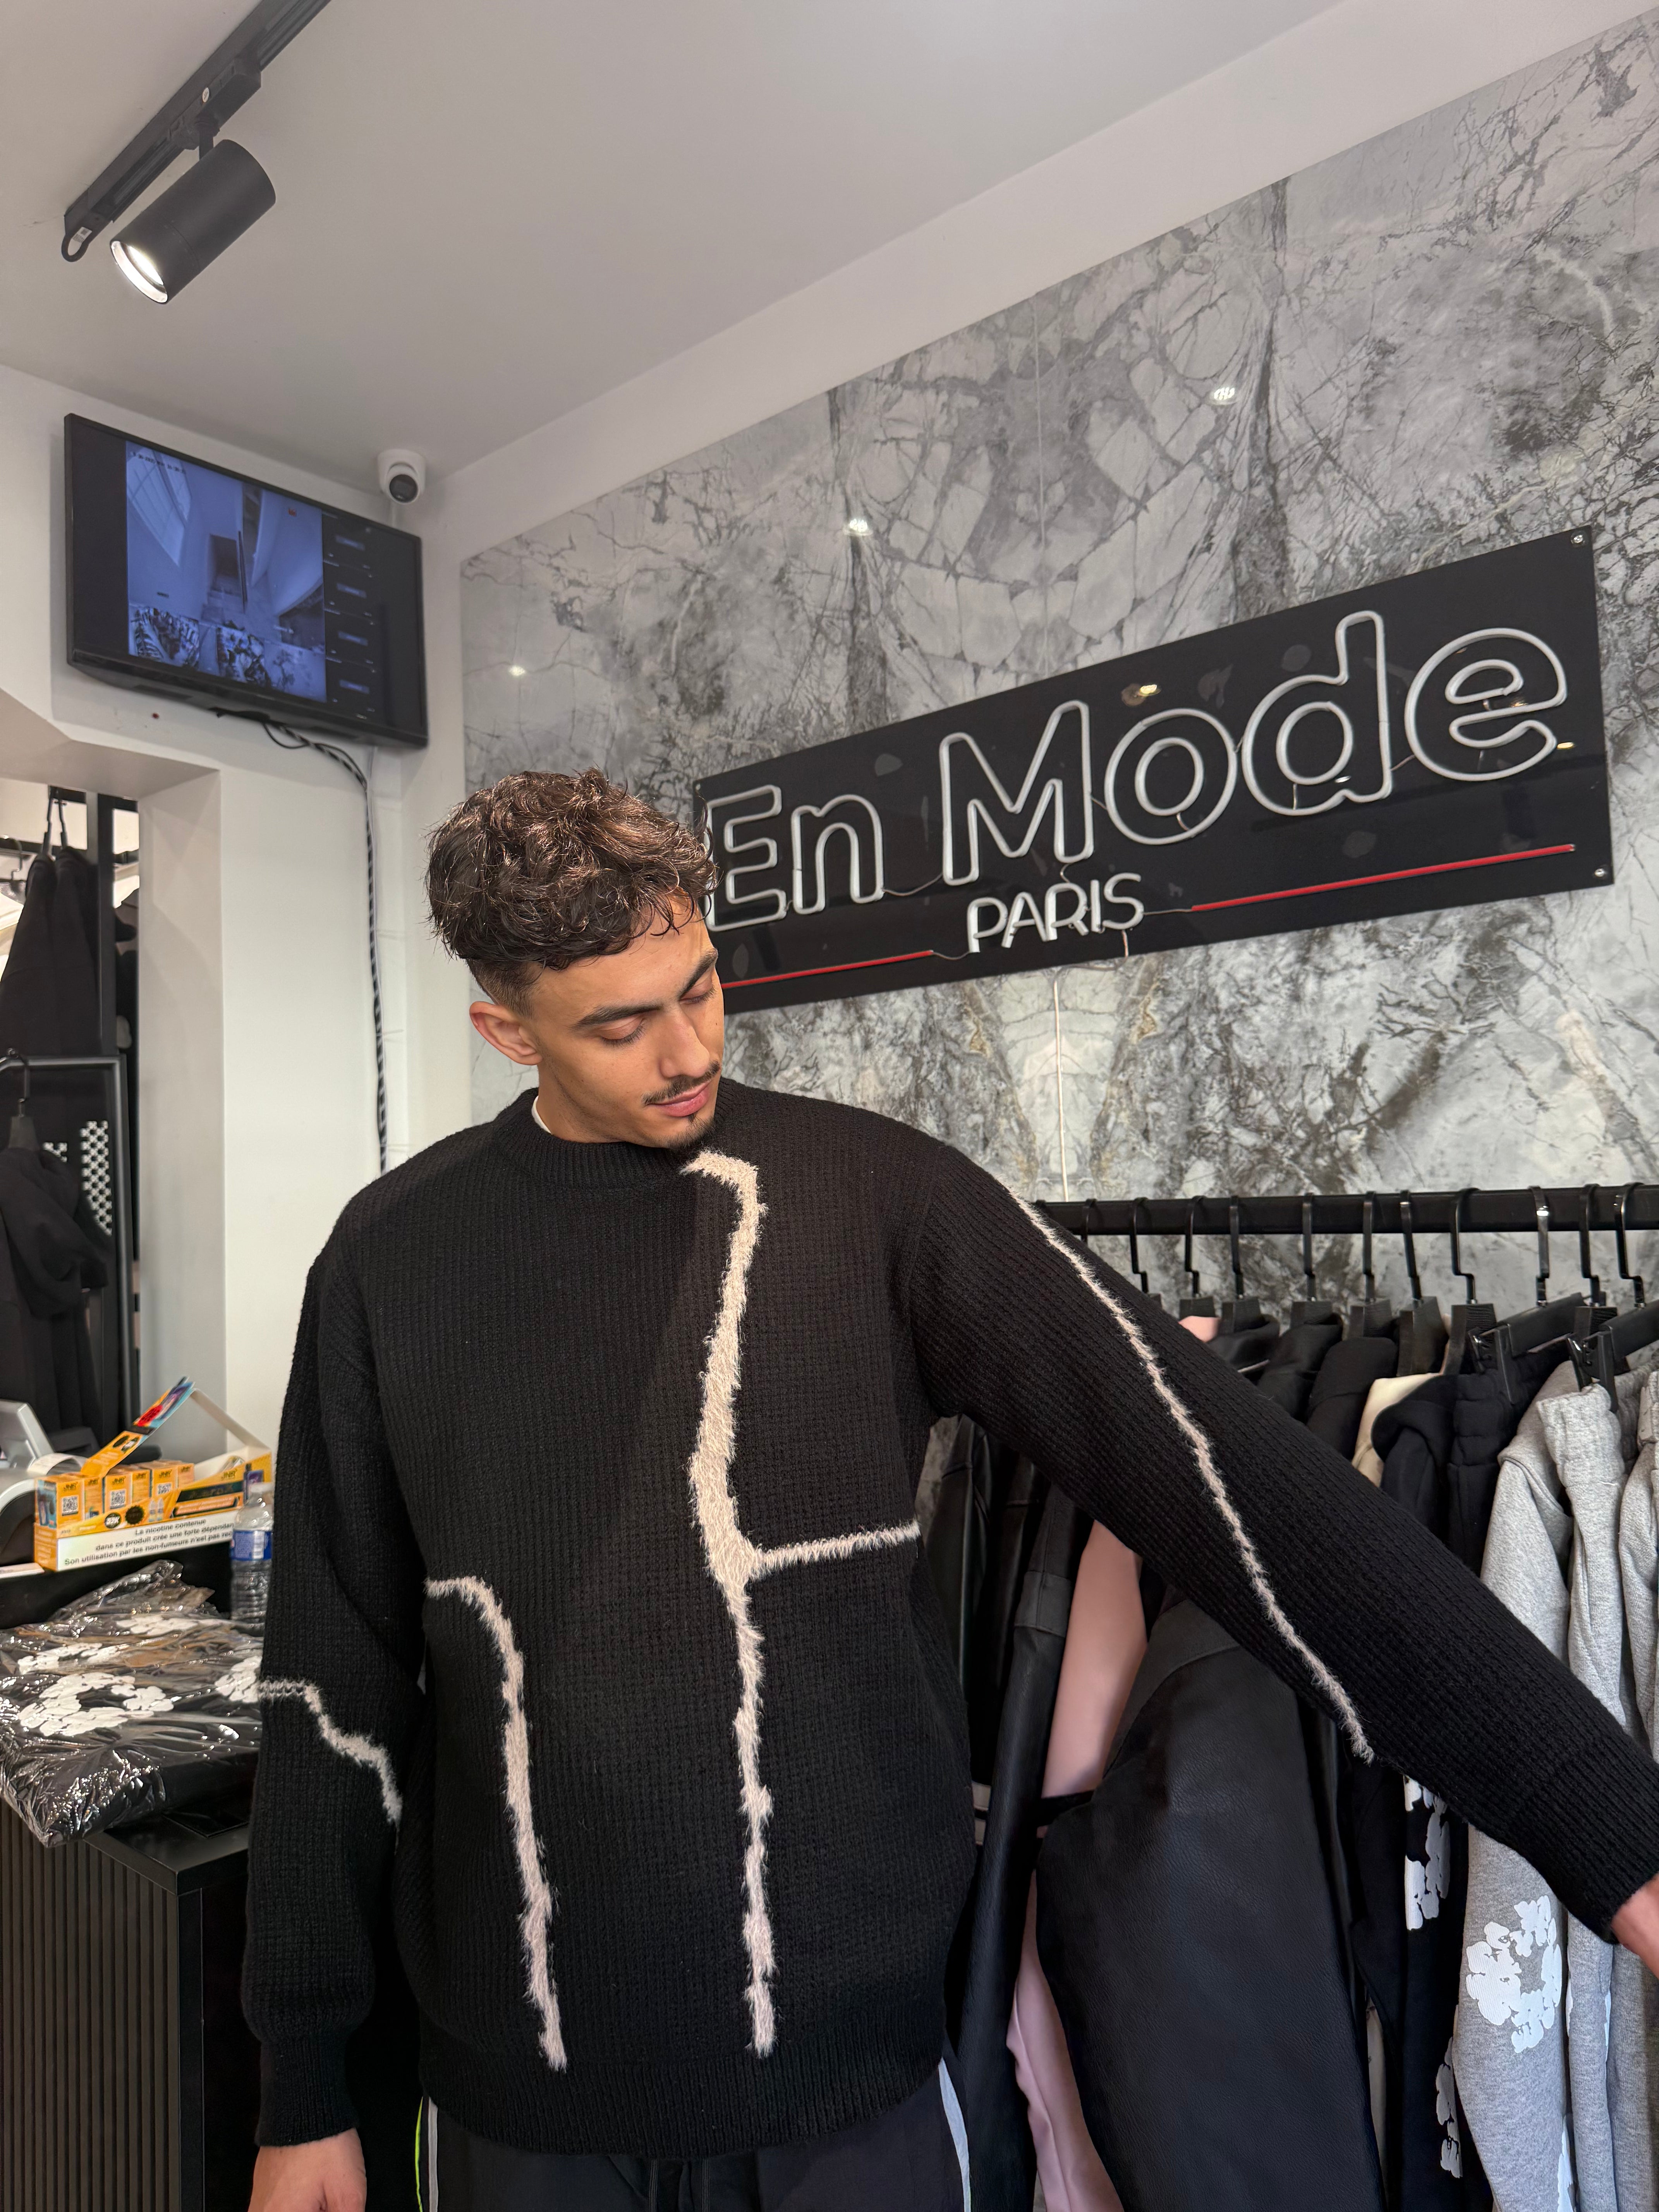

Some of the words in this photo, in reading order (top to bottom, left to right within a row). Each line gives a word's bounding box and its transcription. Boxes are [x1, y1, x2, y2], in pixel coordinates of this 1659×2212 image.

[704, 784, 884, 932] En
[939, 610, 1567, 885] Mode
[967, 872, 1144, 953] PARIS
[146, 1523, 173, 1534] nicotine
[175, 1519, 206, 1529] contenue
[82, 1550, 118, 1562] utilisation
[119, 1549, 131, 1557] par
[145, 1539, 189, 1551] non-fumeurs
[190, 1536, 206, 1544] n'est
[126, 1536, 151, 1547] produit
